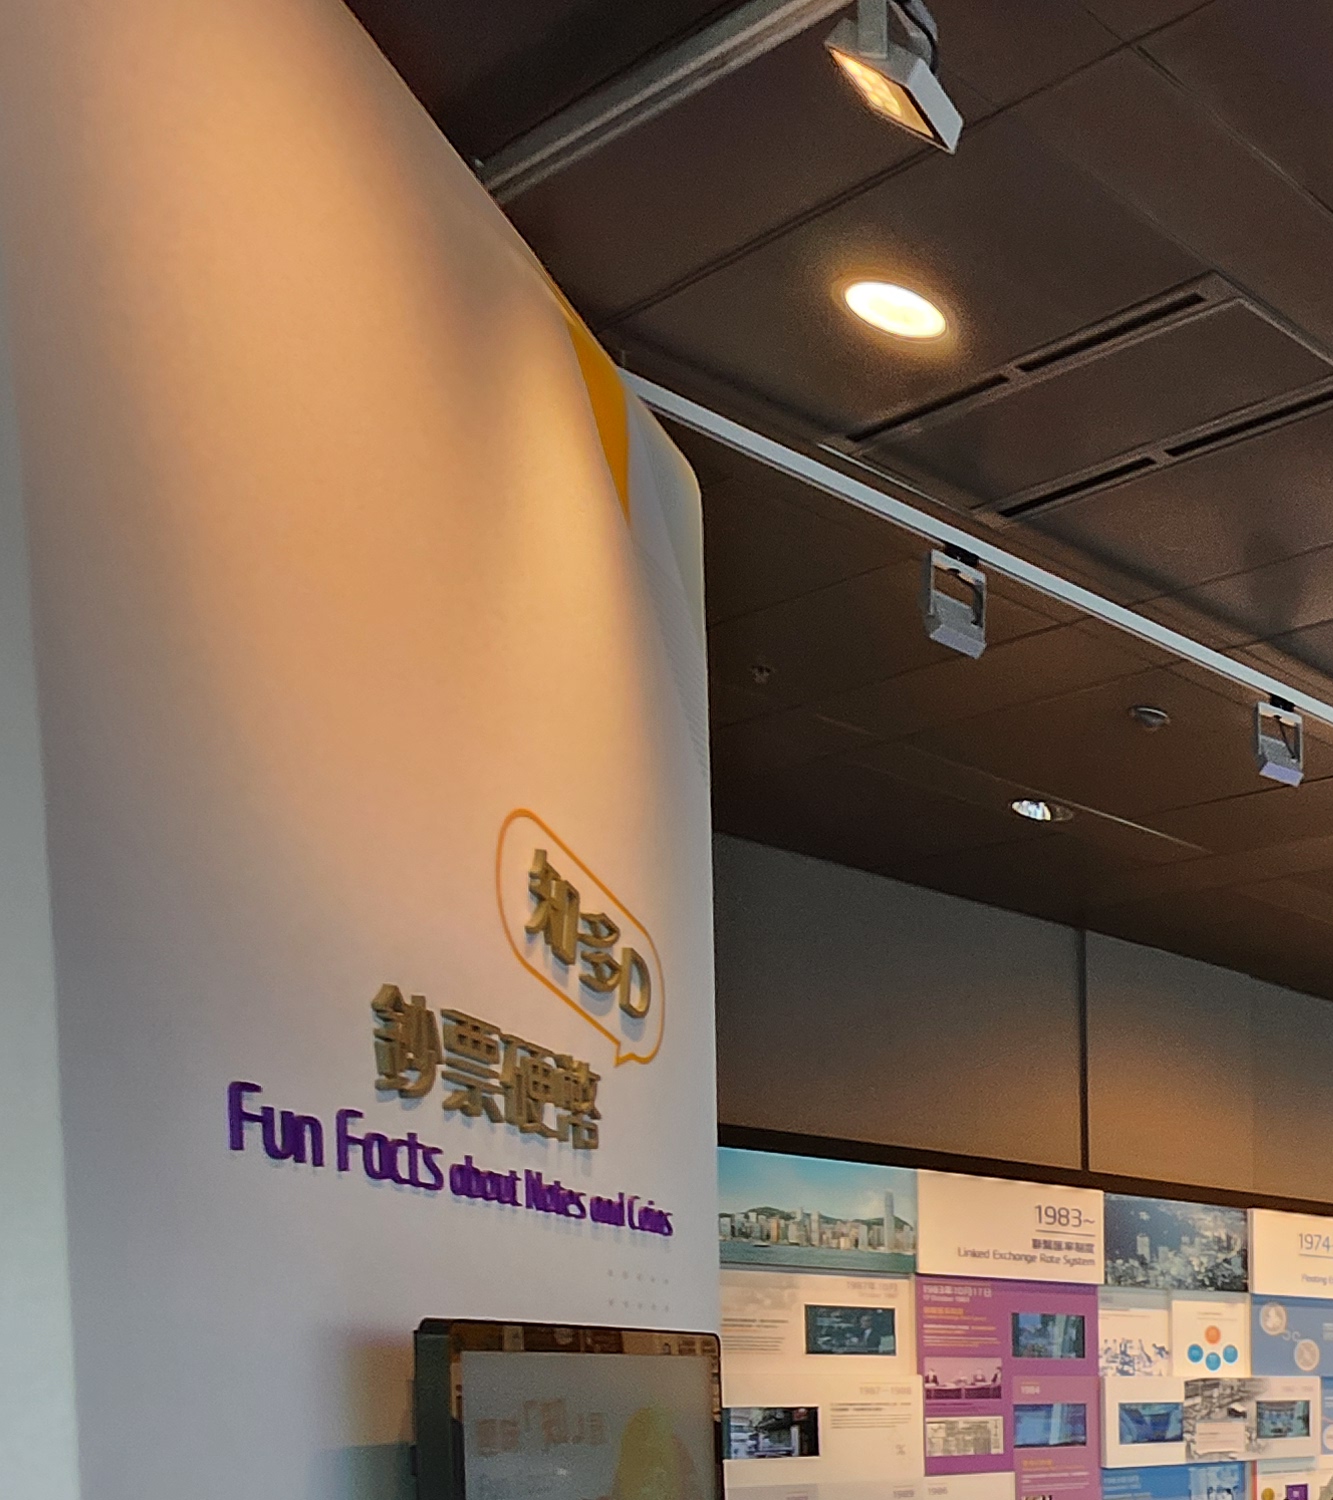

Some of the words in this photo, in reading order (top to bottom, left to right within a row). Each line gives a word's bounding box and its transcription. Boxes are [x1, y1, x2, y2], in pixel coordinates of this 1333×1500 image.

[226, 1080, 324, 1168] Fun
[335, 1108, 445, 1191] Facts
[448, 1154, 523, 1207] about
[524, 1168, 587, 1219] Notes
[589, 1191, 626, 1227] and
[627, 1195, 674, 1237] Coins
[957, 1246, 990, 1260] Linked
[992, 1249, 1038, 1265] Exchange
[1040, 1252, 1062, 1264] Rate
[1063, 1254, 1096, 1268] System
